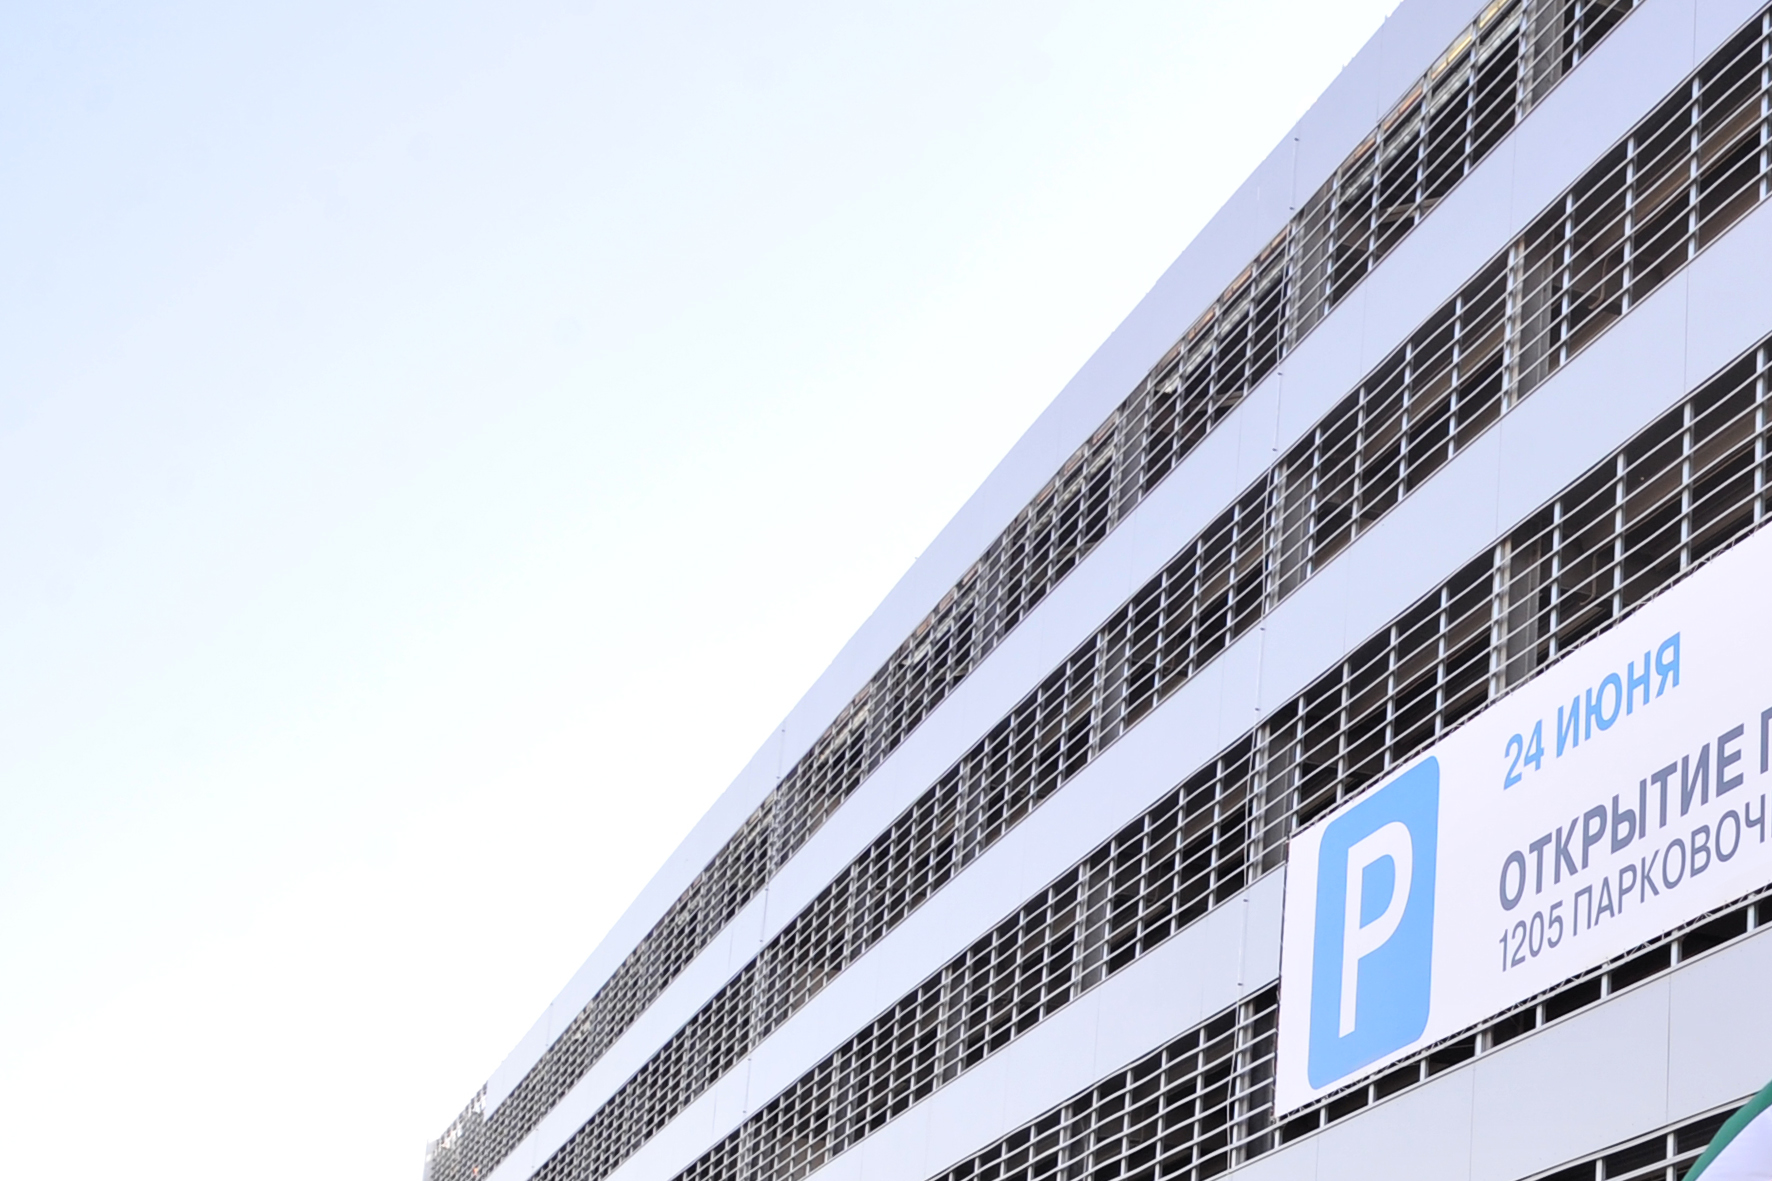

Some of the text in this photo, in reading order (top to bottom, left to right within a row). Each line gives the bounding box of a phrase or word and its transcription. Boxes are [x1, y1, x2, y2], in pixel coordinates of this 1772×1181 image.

[1503, 630, 1681, 791] 24 ИЮНЯ
[1499, 722, 1745, 911] ОТКРЫТИЕ
[1338, 820, 1414, 1039] P
[1499, 899, 1564, 973] 1205
